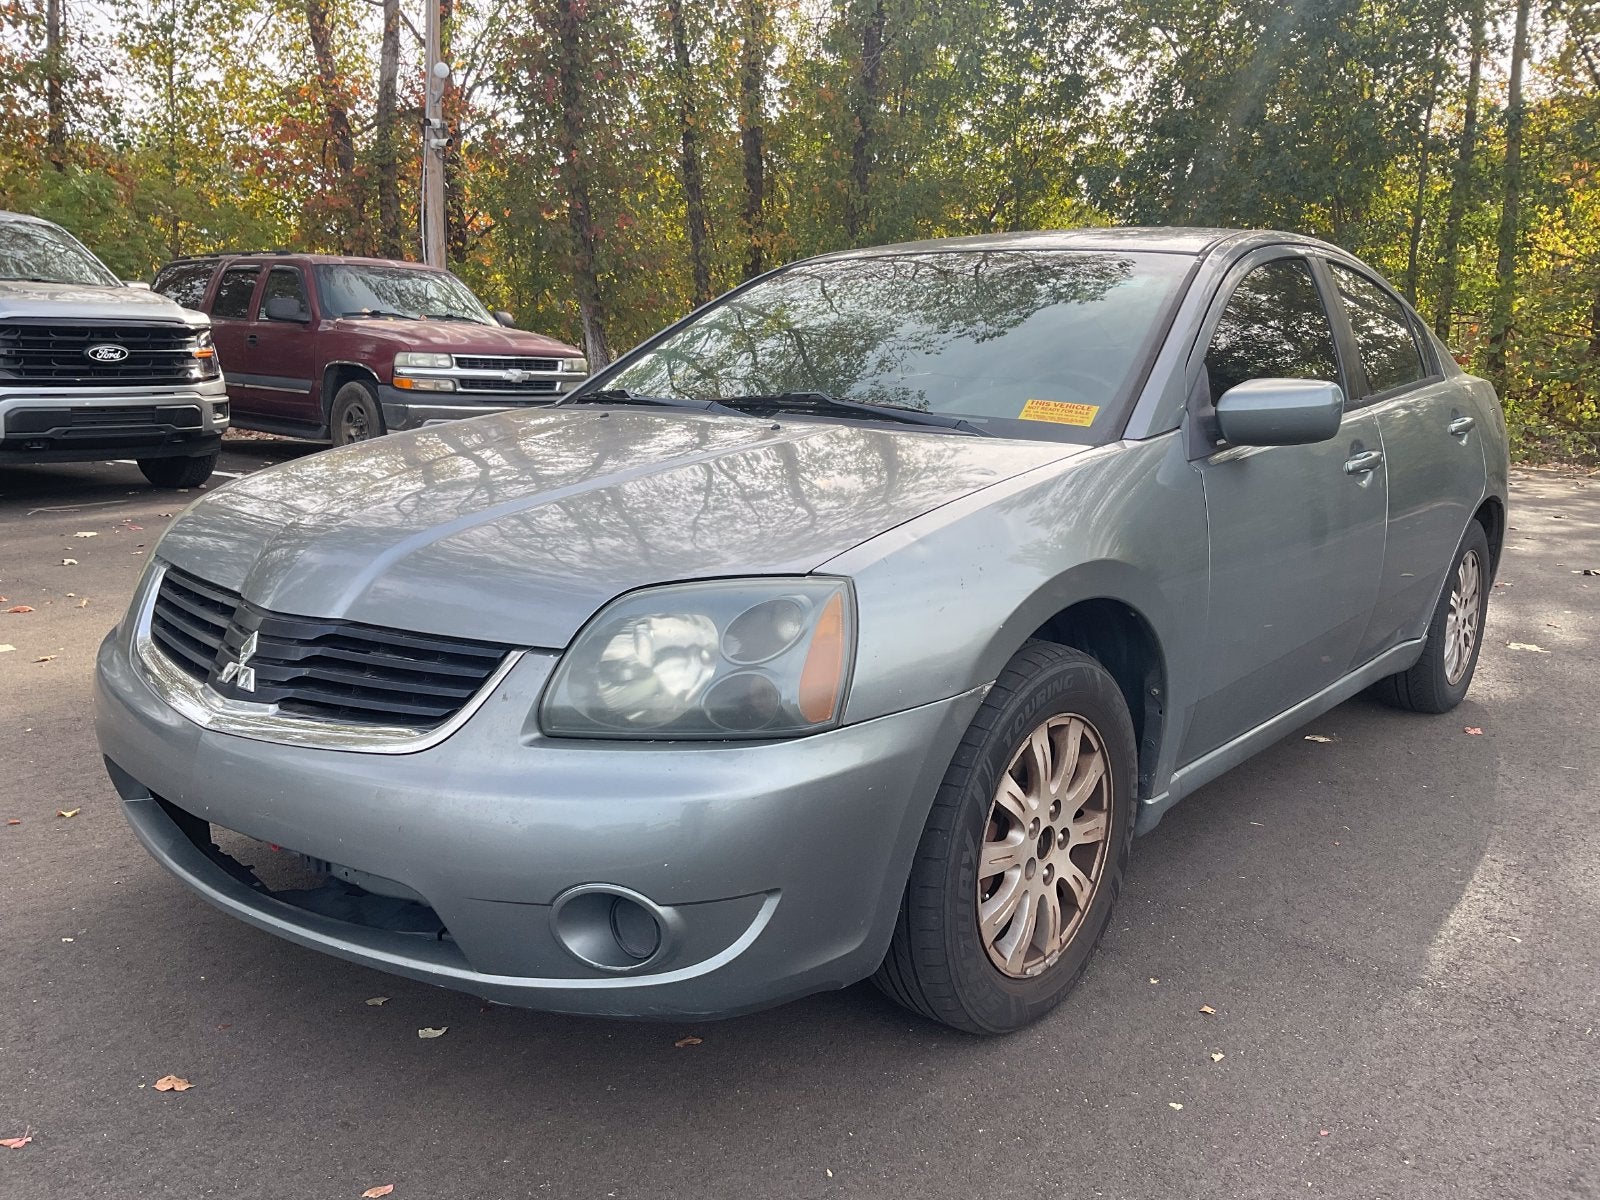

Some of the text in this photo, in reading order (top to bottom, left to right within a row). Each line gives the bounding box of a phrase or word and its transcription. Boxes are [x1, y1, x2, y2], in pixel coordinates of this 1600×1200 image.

[96, 348, 121, 359] Ford
[1053, 402, 1093, 412] VEHICLE
[1003, 674, 1074, 748] TOURING
